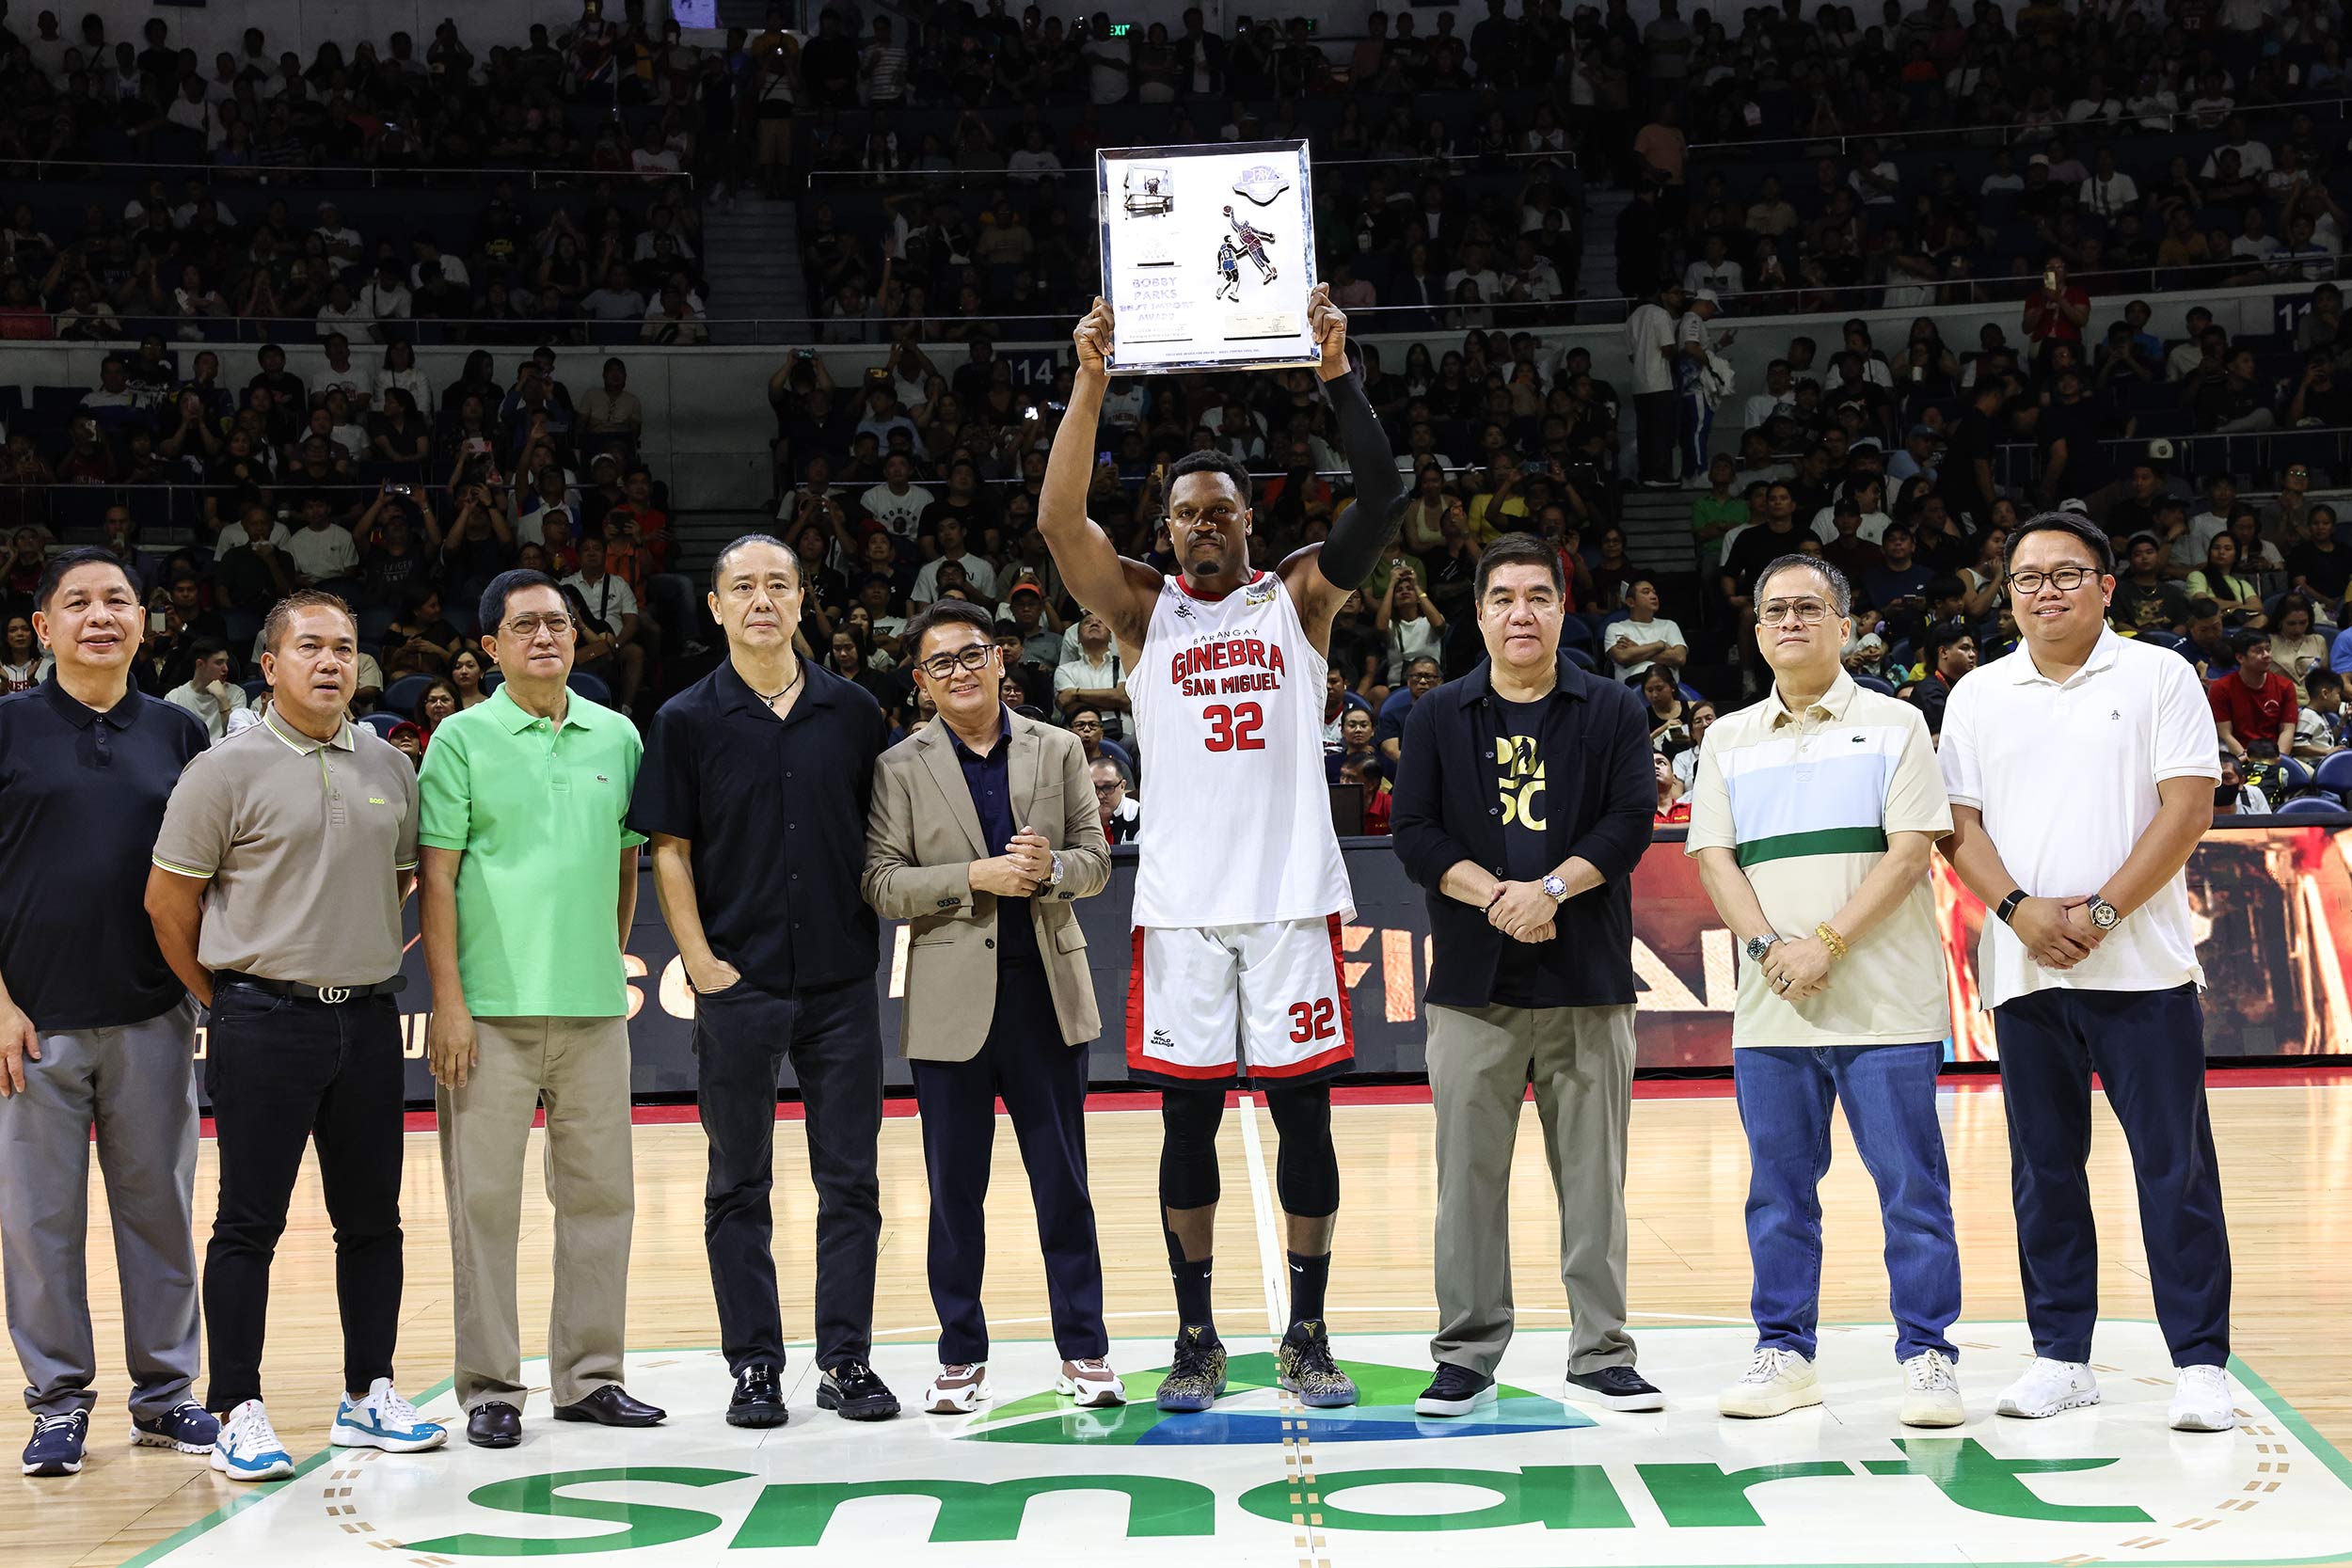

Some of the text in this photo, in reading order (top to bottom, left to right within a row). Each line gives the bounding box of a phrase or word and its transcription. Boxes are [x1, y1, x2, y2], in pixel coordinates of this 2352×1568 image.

[1132, 277, 1178, 289] BOBBY
[1134, 289, 1178, 300] PARKS
[882, 507, 917, 525] TOKYO
[1193, 628, 1259, 645] BARANGAY
[1171, 639, 1286, 685] GINEBRA
[1183, 673, 1280, 697] SAN MIGUEL
[1202, 702, 1265, 752] 32
[369, 797, 385, 805] BOSS
[1288, 996, 1337, 1044] 32
[392, 1438, 2156, 1556] smart
